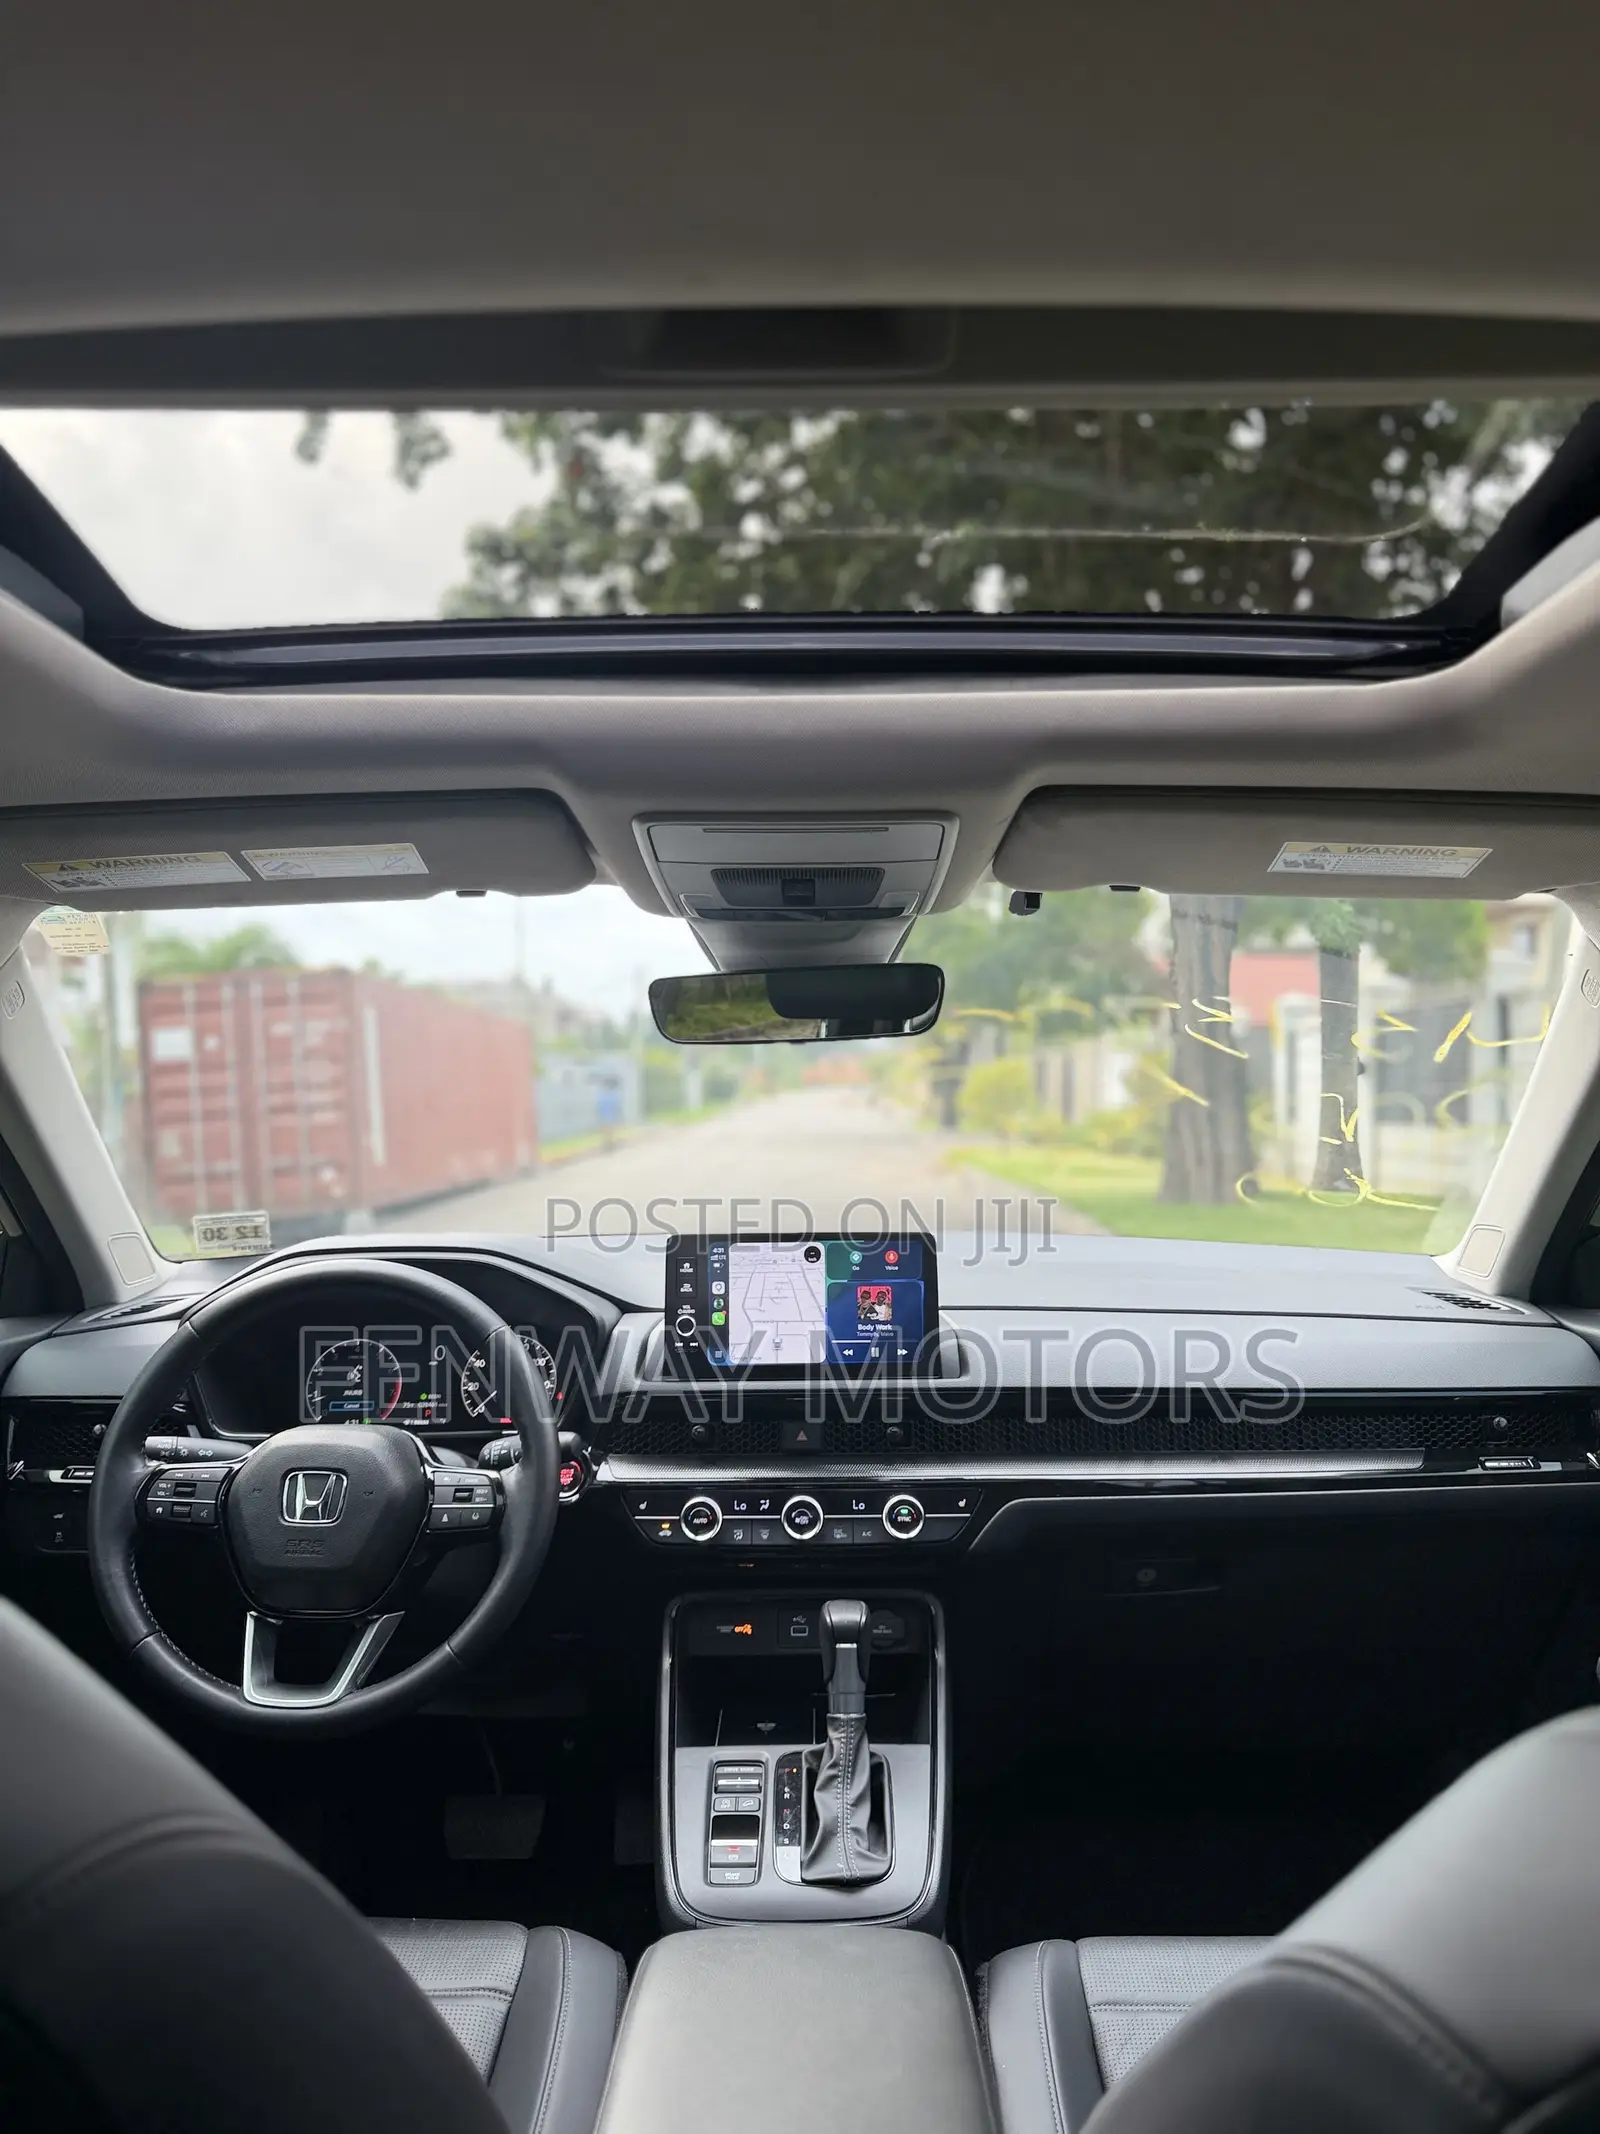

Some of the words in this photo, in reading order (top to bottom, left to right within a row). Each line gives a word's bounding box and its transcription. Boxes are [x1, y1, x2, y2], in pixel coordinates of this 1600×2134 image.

[1346, 846, 1459, 856] WARNING
[88, 854, 202, 869] WARNING
[857, 1324, 875, 1332] Body
[434, 1344, 446, 1361] 0
[474, 1359, 486, 1368] 40
[467, 1382, 479, 1391] 20
[424, 1408, 432, 1417] P
[734, 1500, 747, 1511] Lo
[852, 1500, 865, 1510] Lo
[285, 1538, 325, 1548] SRS
